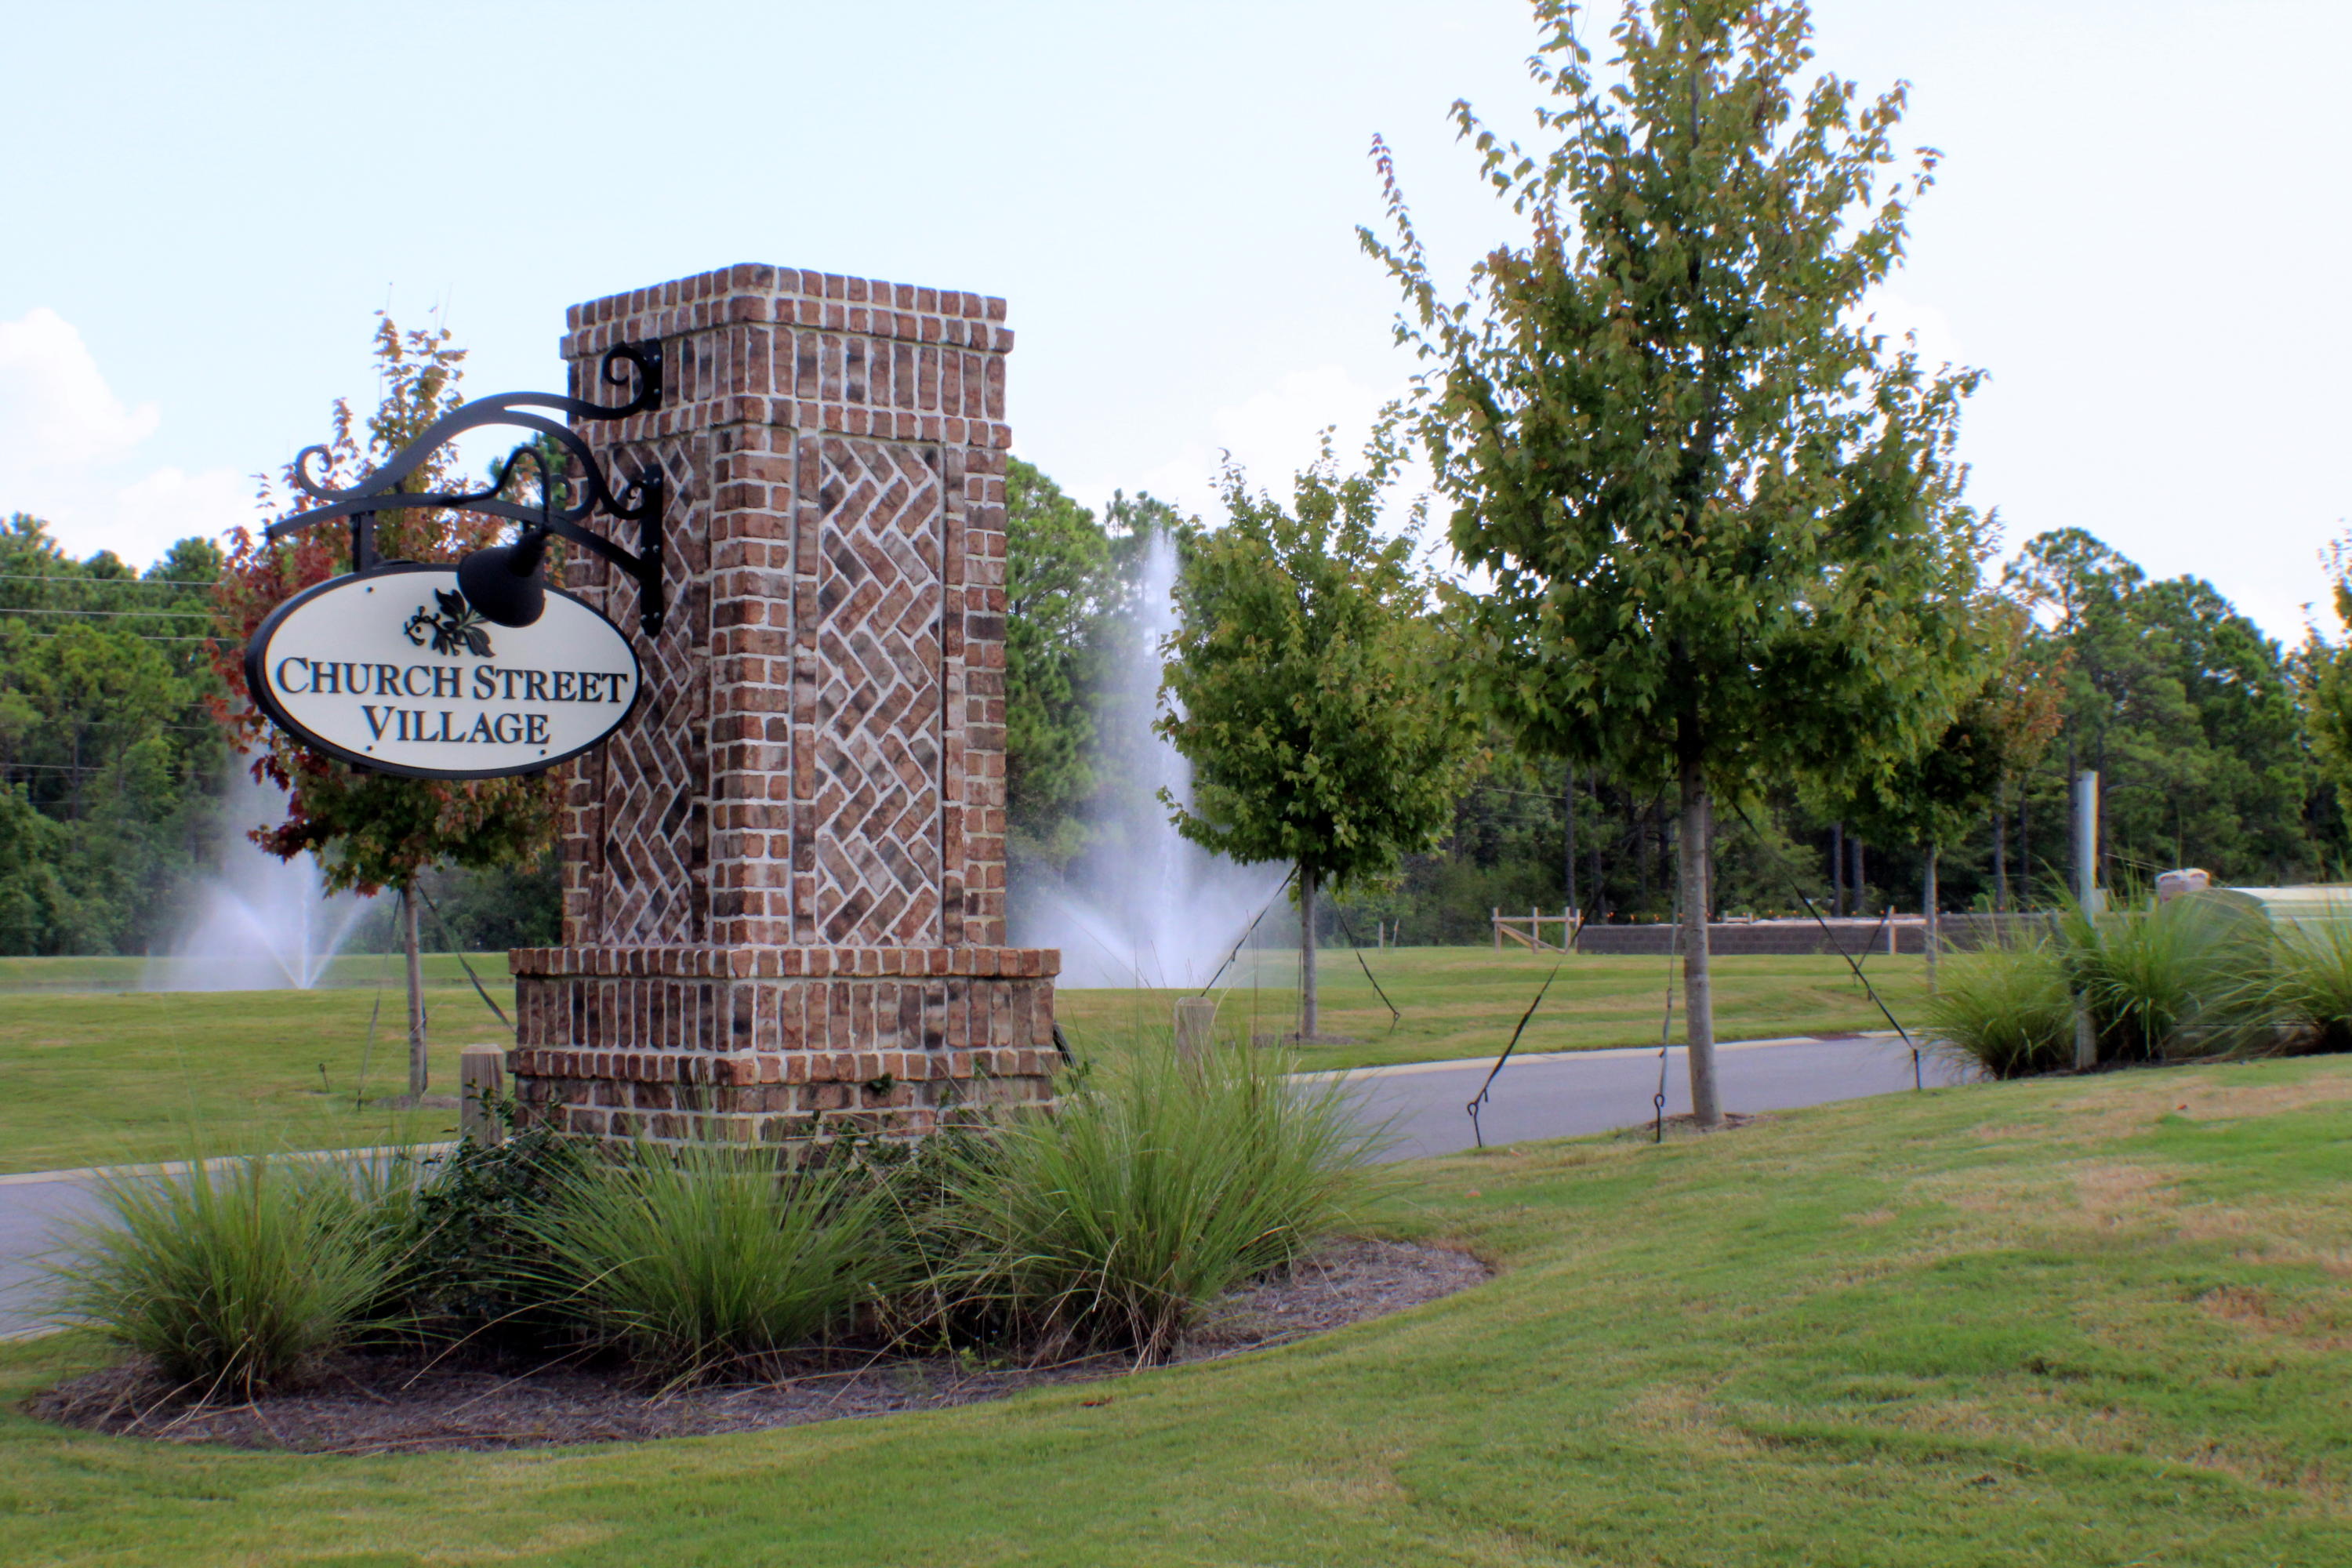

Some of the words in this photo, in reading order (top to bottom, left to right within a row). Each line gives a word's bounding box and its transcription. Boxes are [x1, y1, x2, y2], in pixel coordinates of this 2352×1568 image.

[277, 656, 463, 698] CHURCH
[472, 664, 628, 703] STREET
[361, 705, 550, 744] VILLAGE
